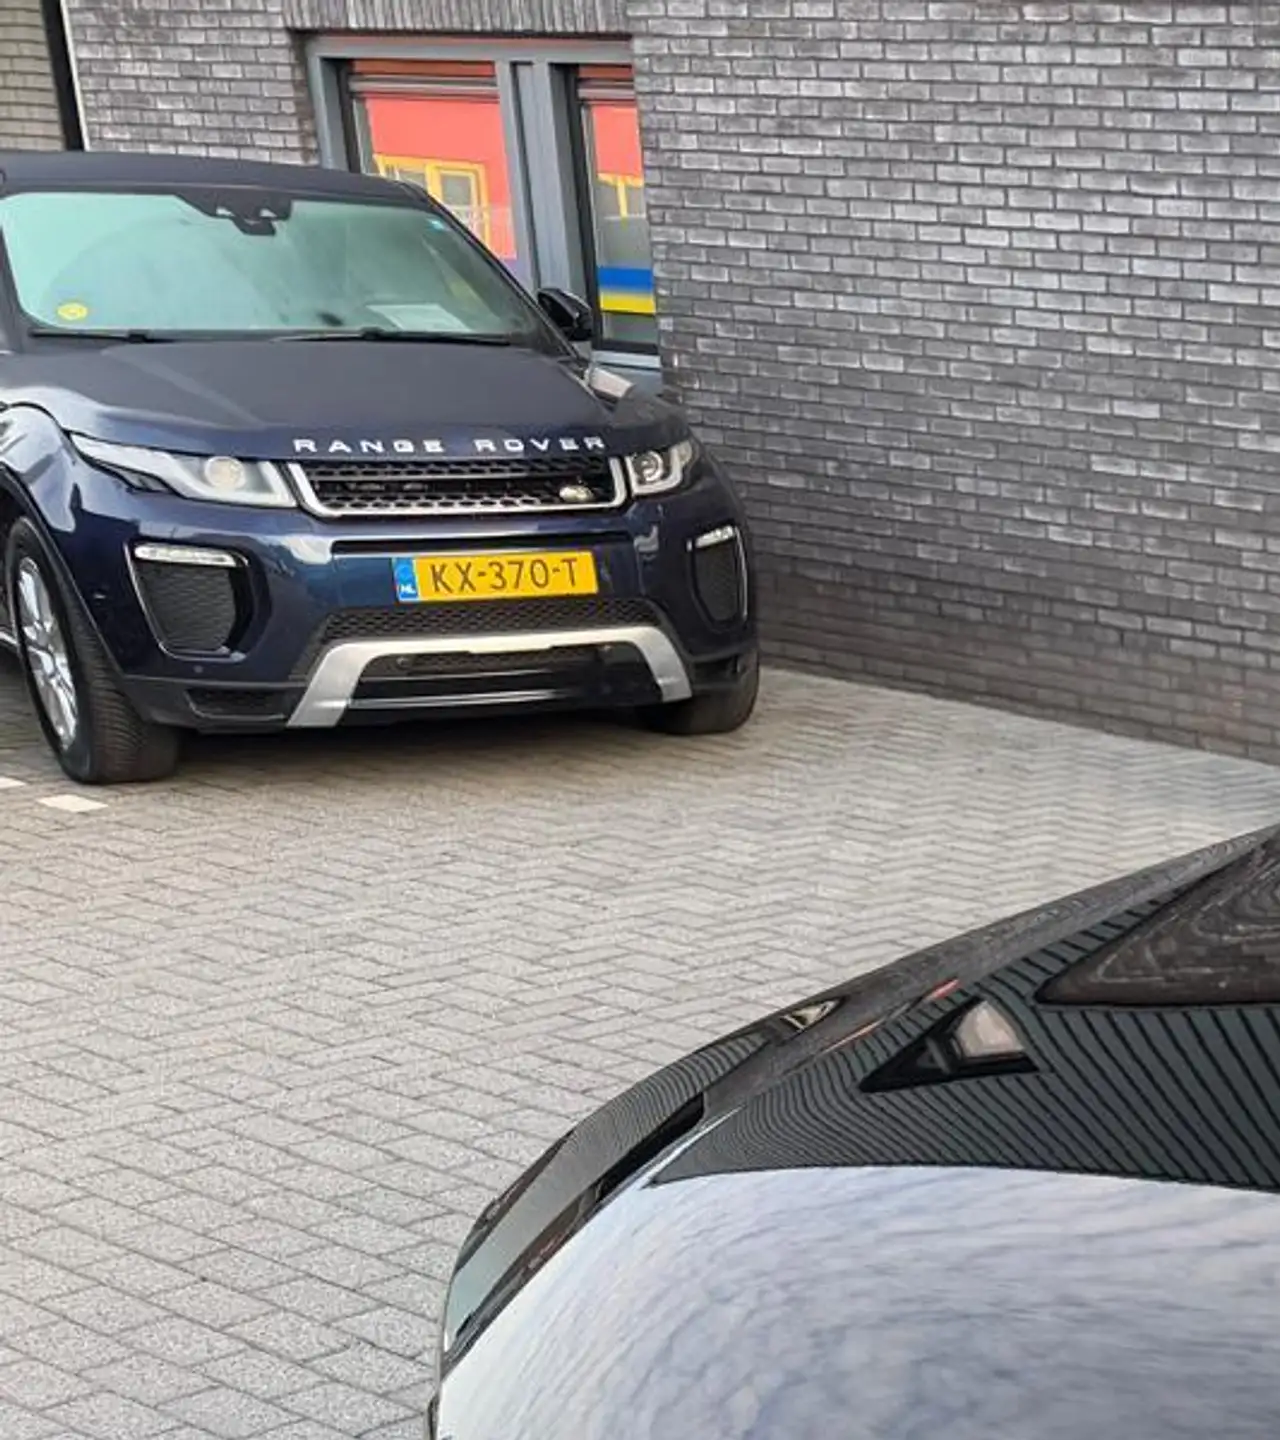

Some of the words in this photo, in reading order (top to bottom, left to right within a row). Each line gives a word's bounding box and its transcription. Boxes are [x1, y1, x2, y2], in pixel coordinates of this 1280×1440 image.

[293, 438, 444, 453] RANGE
[473, 436, 605, 452] ROVER
[430, 557, 578, 594] KX-370-T
